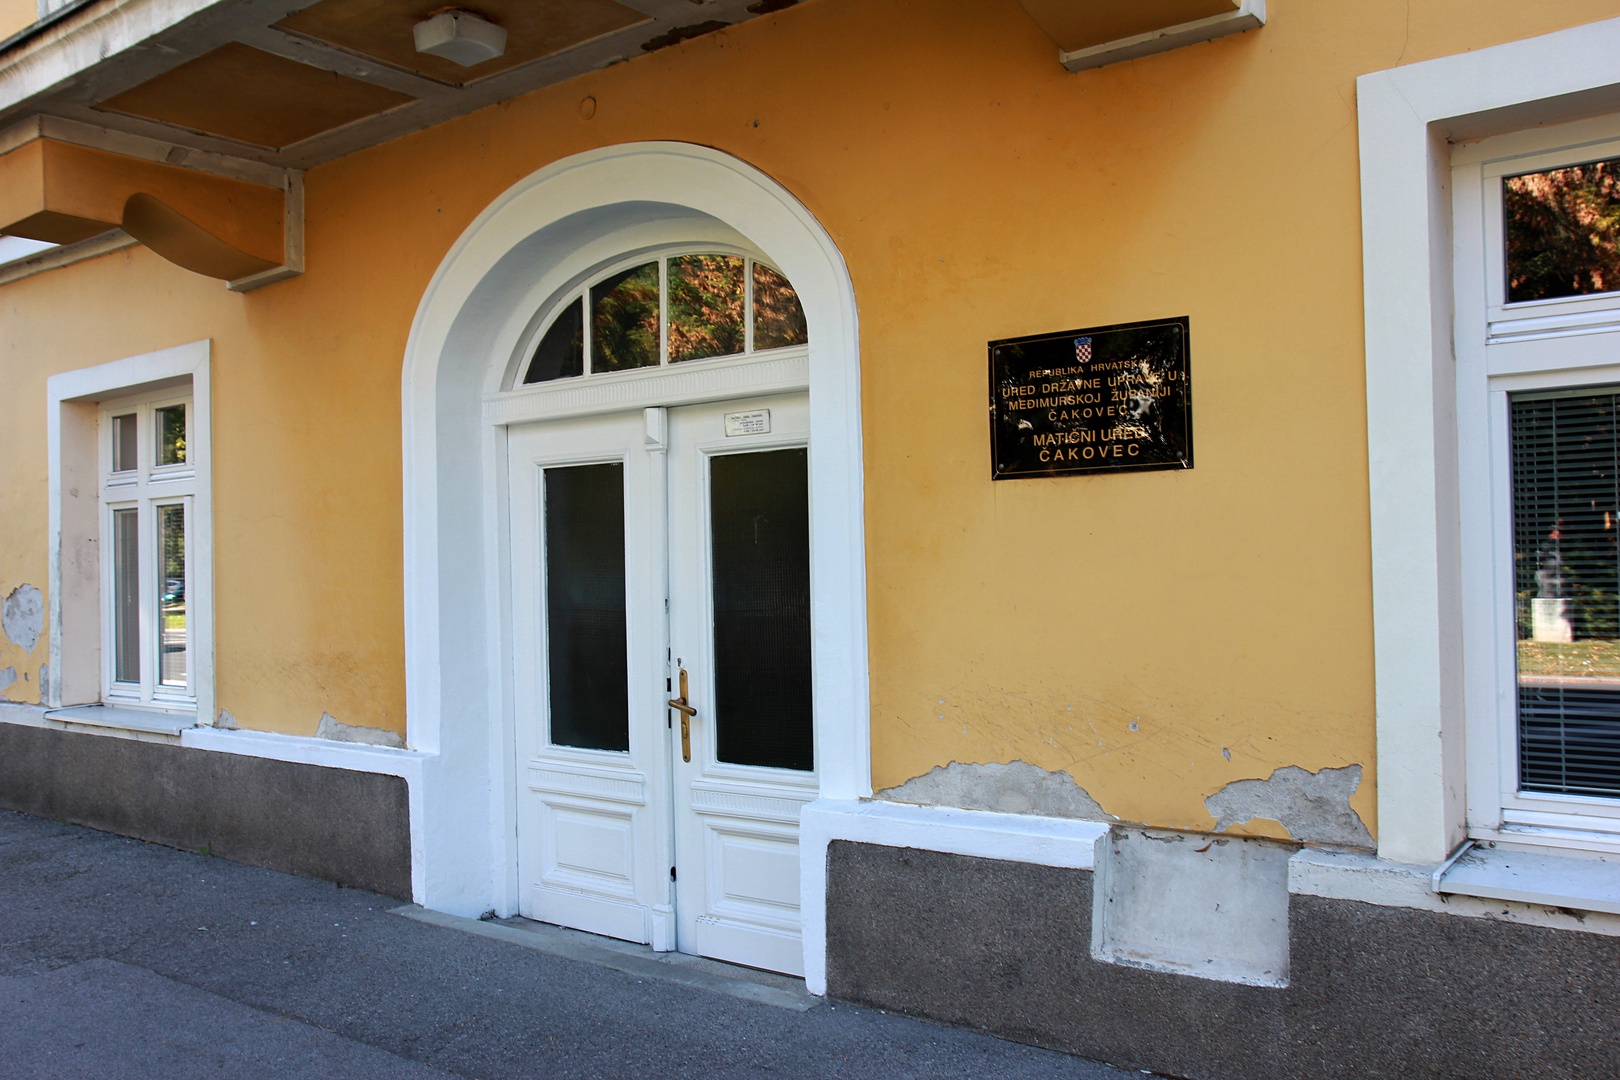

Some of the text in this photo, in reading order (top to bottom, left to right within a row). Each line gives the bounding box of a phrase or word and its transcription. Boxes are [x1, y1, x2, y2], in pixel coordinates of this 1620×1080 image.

[1029, 360, 1145, 378] REPUBLIKA HRVATSKA
[1002, 385, 1036, 397] URED
[1042, 379, 1101, 394] DRŽAVNE
[1168, 371, 1177, 381] U
[1009, 386, 1171, 411] MEĐIMURSKOJ ŽUPANIJI
[1048, 405, 1128, 421] ČAKOVEC
[1033, 428, 1096, 446] MATIČNI
[1039, 443, 1139, 462] ČAKOVEC
